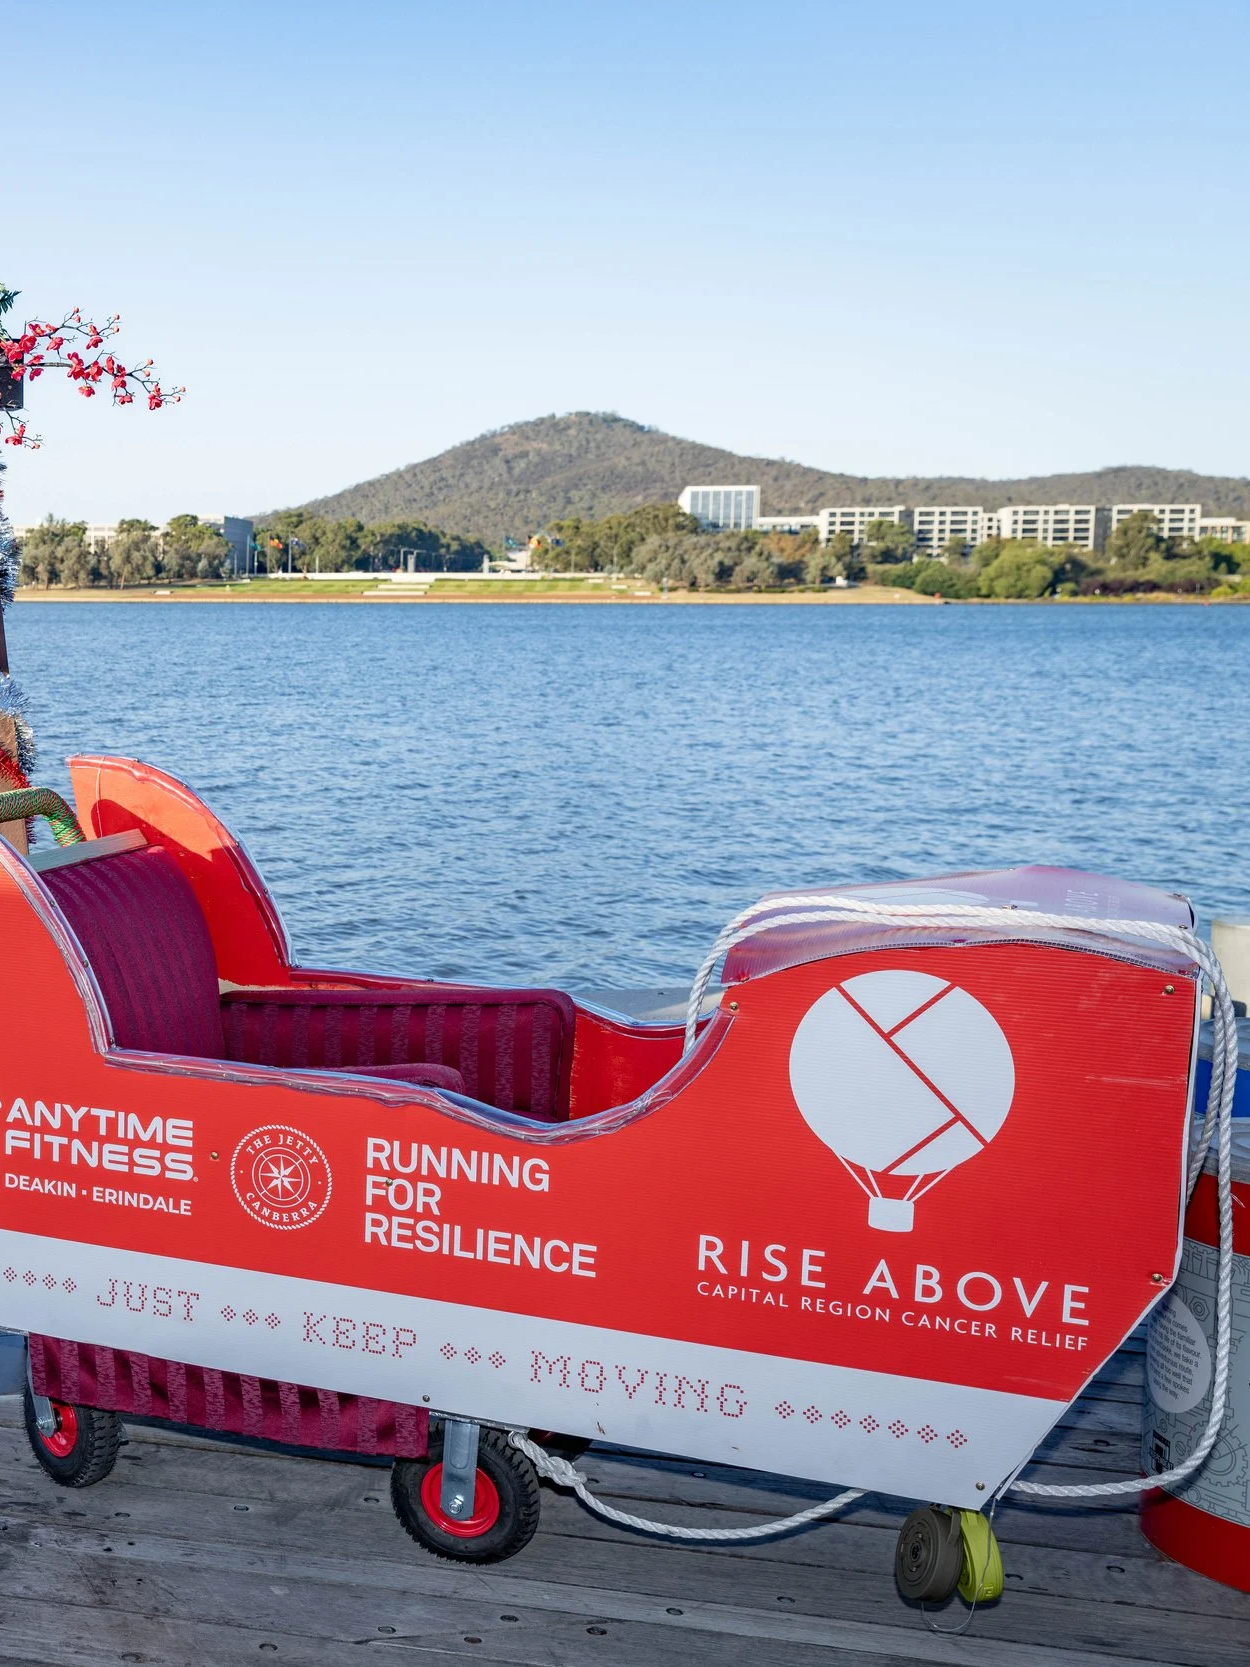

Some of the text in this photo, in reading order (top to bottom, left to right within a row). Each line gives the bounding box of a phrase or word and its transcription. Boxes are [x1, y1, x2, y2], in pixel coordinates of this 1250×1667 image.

[6, 1098, 194, 1148] ANYTIME
[6, 1130, 195, 1181] FITNESS
[246, 1133, 319, 1165] THE JETTY
[366, 1137, 550, 1194] RUNNING
[5, 1173, 192, 1216] DEAKIN ERINDALE
[246, 1192, 318, 1222] CANBERRA
[366, 1175, 443, 1216] FOR
[365, 1213, 598, 1279] RESILIENCE
[697, 1234, 1090, 1326] RISE ABOVE
[697, 1281, 1089, 1352] CAPITAL REGION CANCER RELIEF
[96, 1278, 748, 1419] JUST KEEP MOVING
